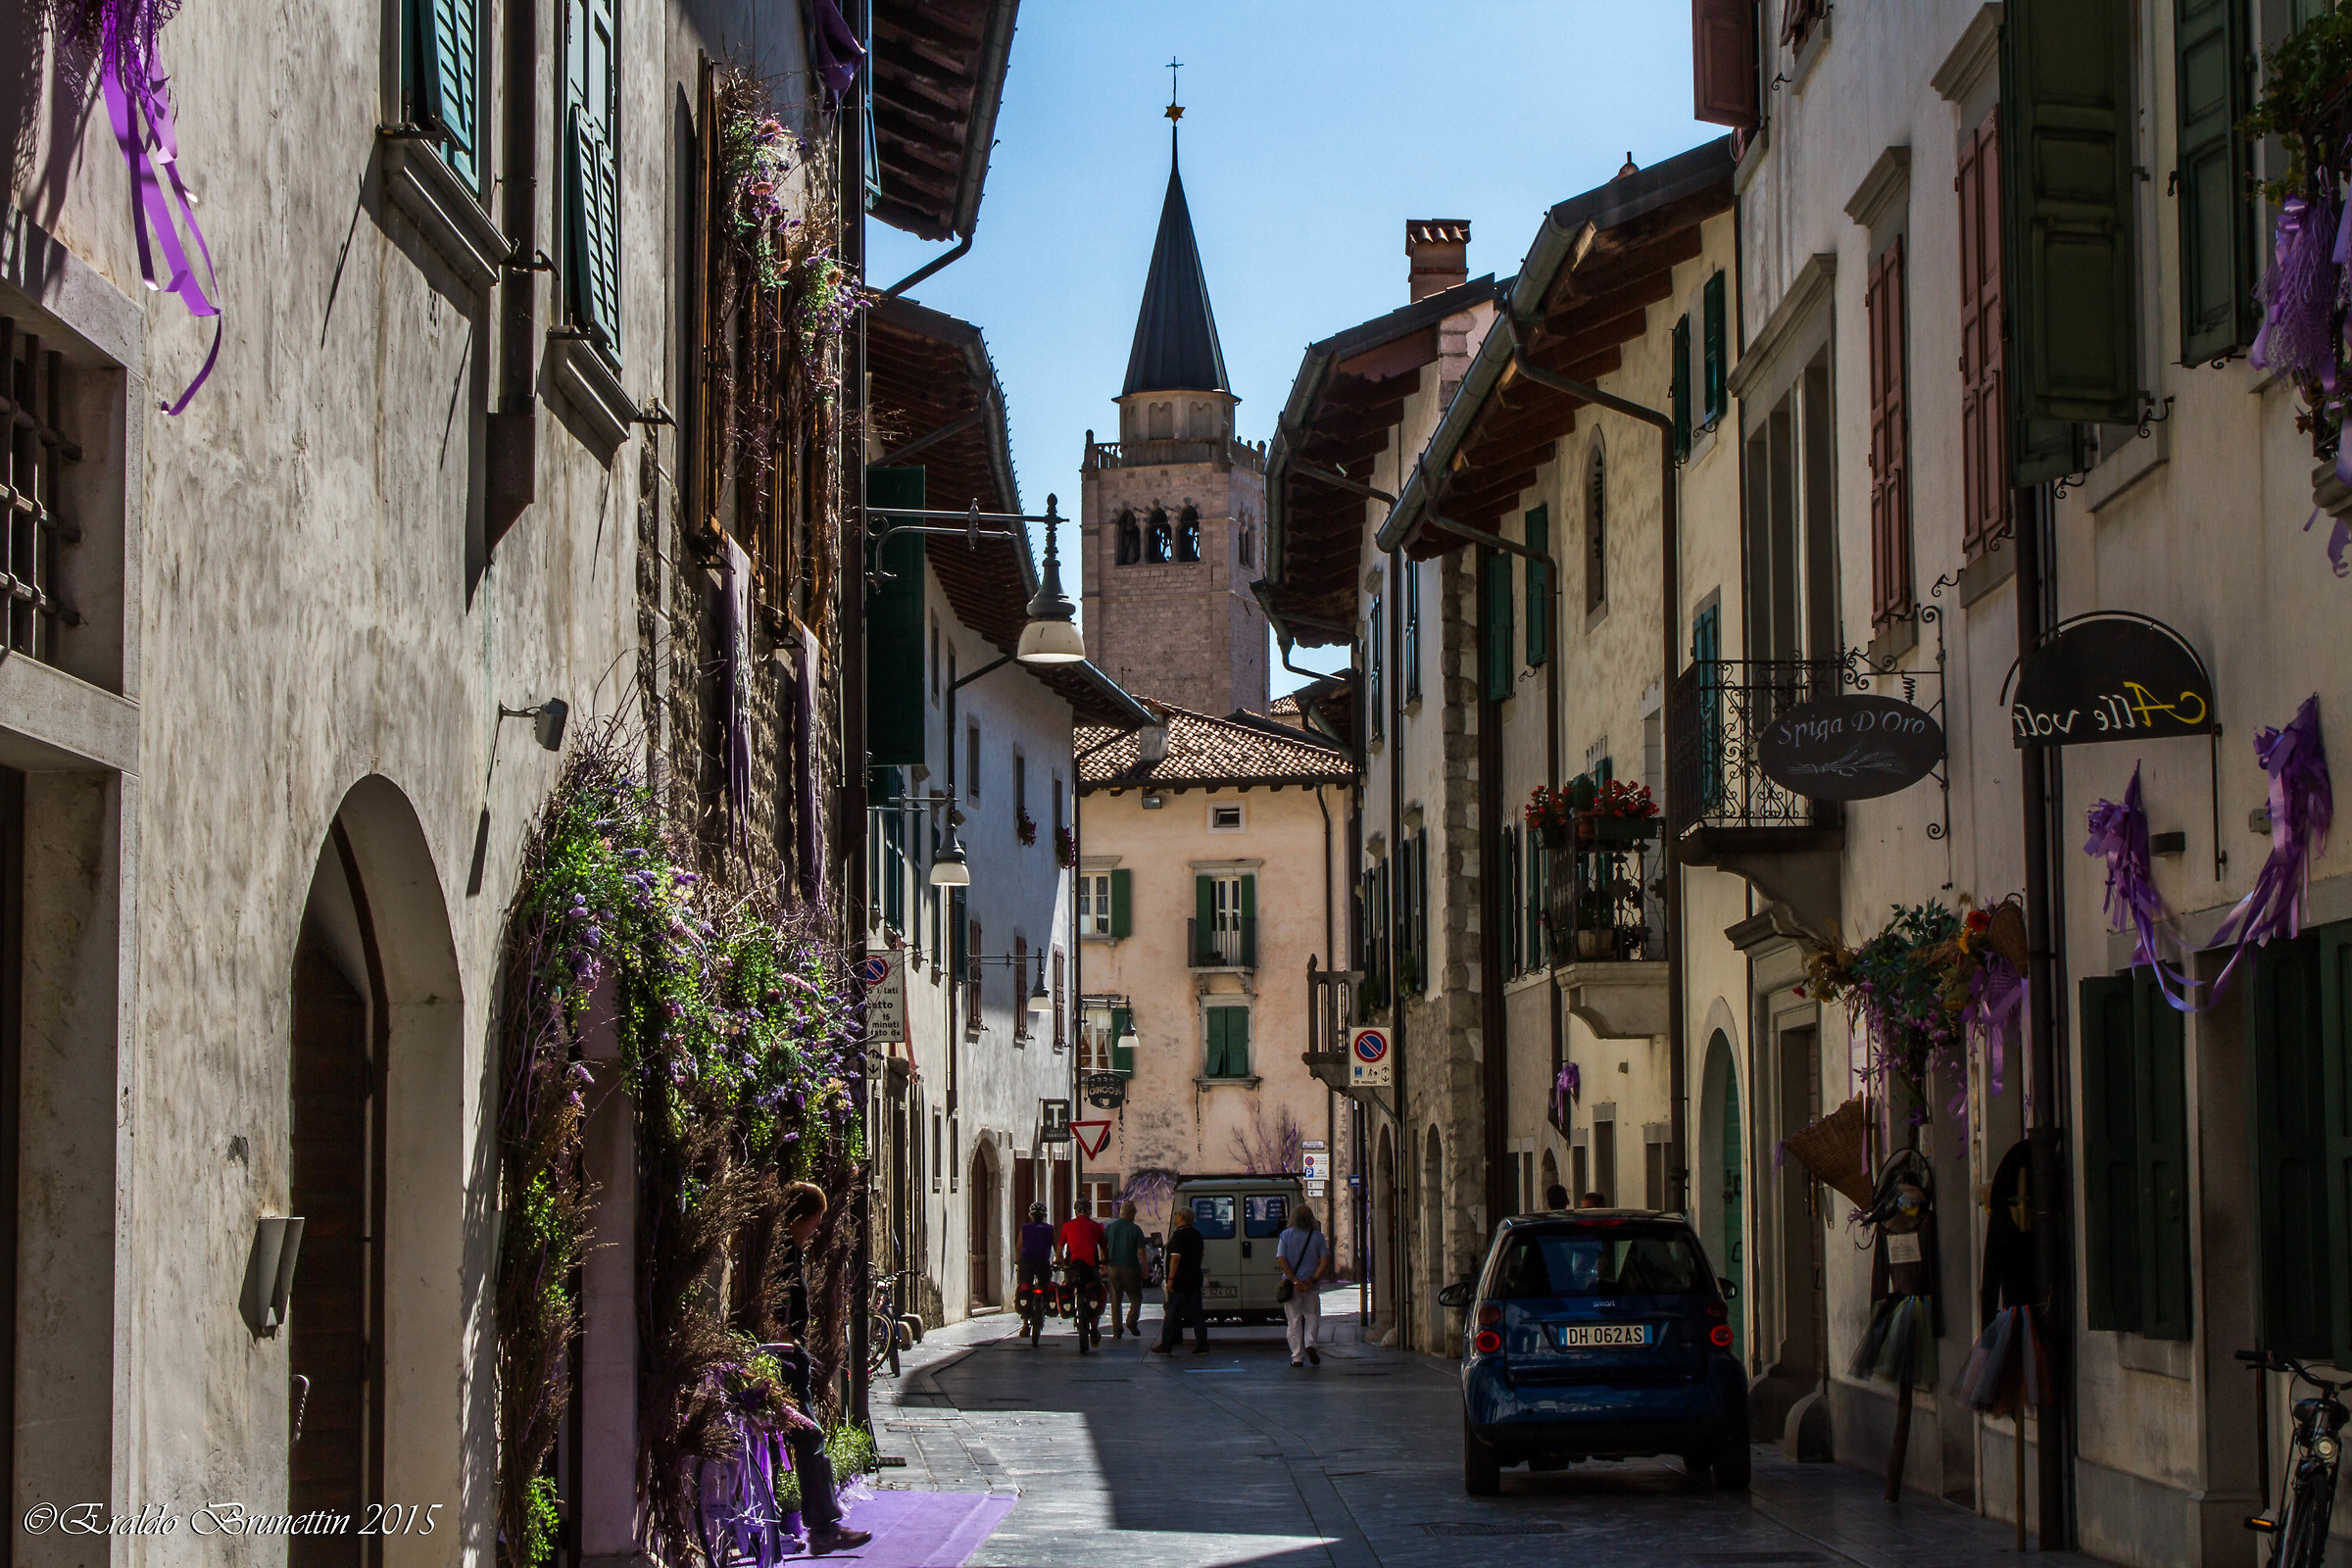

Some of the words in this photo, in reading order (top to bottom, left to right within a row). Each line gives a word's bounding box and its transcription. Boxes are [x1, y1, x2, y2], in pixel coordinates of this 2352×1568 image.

[1778, 713, 1843, 748] Spiga
[1852, 710, 1926, 735] D'Oro
[1048, 1103, 1064, 1129] T
[1569, 1328, 1589, 1345] DH
